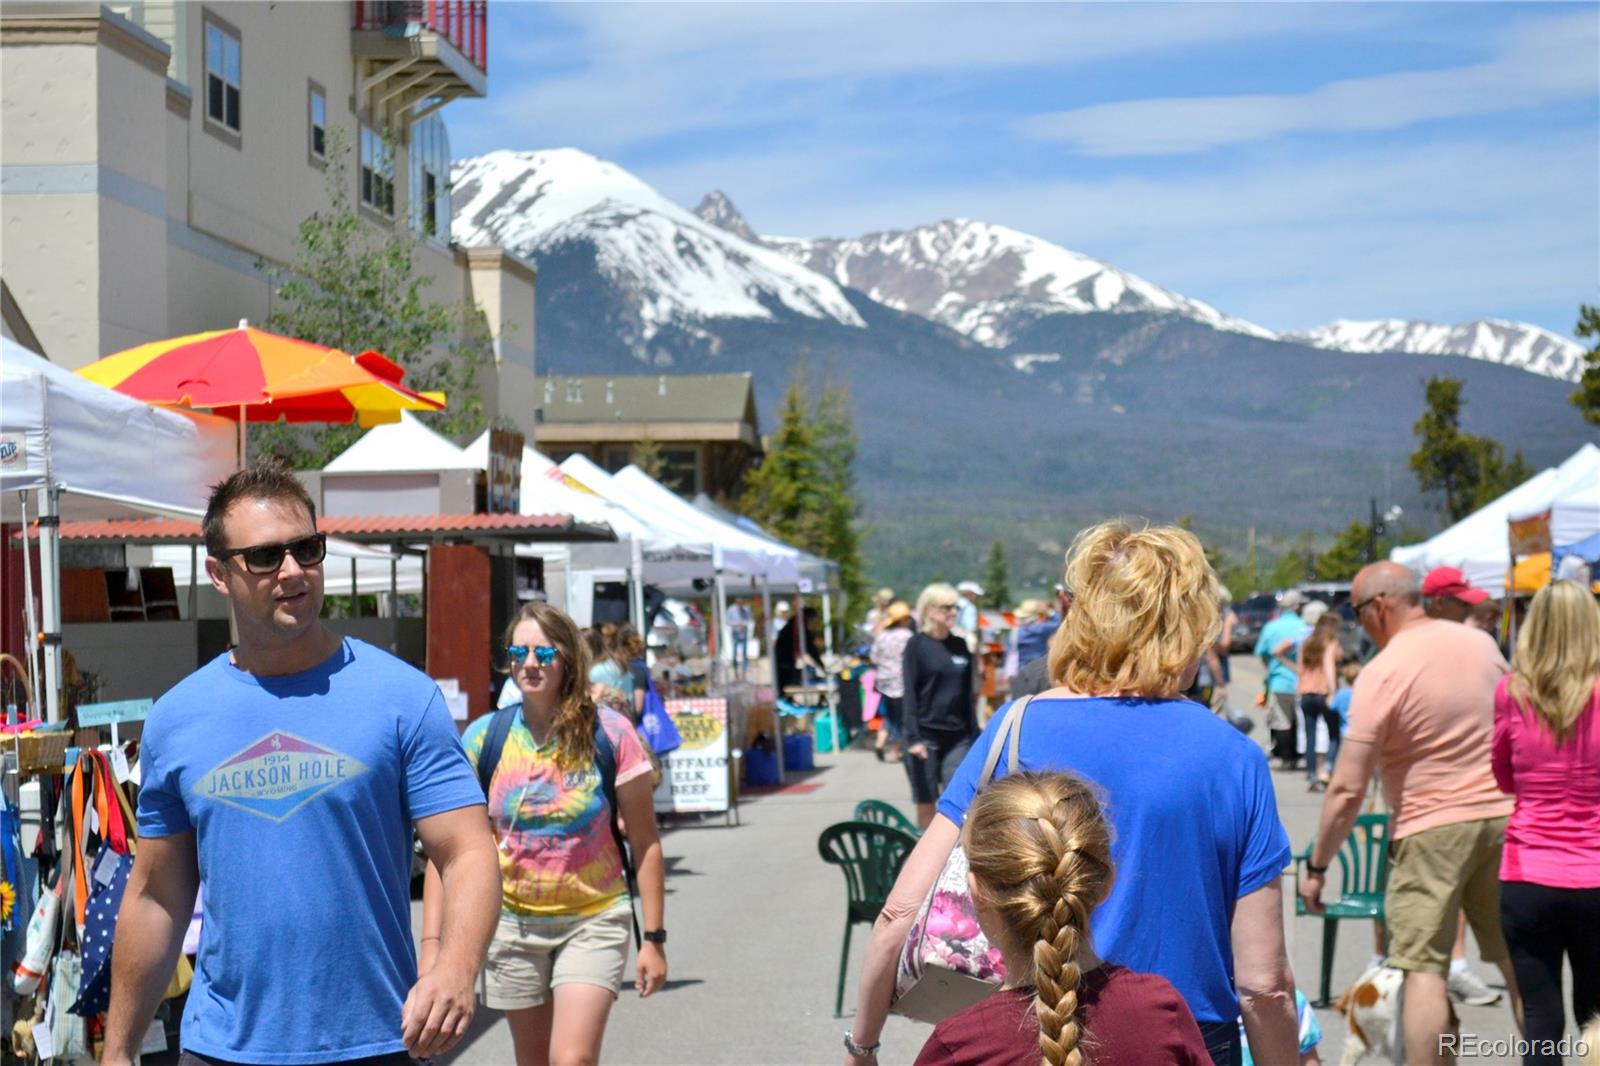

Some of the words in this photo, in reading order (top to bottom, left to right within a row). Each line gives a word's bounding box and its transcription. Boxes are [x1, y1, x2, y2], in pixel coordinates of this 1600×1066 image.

[263, 754, 290, 766] 1914
[207, 765, 291, 794] JACKSON
[299, 759, 346, 780] HOLE
[674, 771, 706, 782] ELK
[256, 784, 298, 796] WYOMING
[670, 784, 711, 796] BEEF
